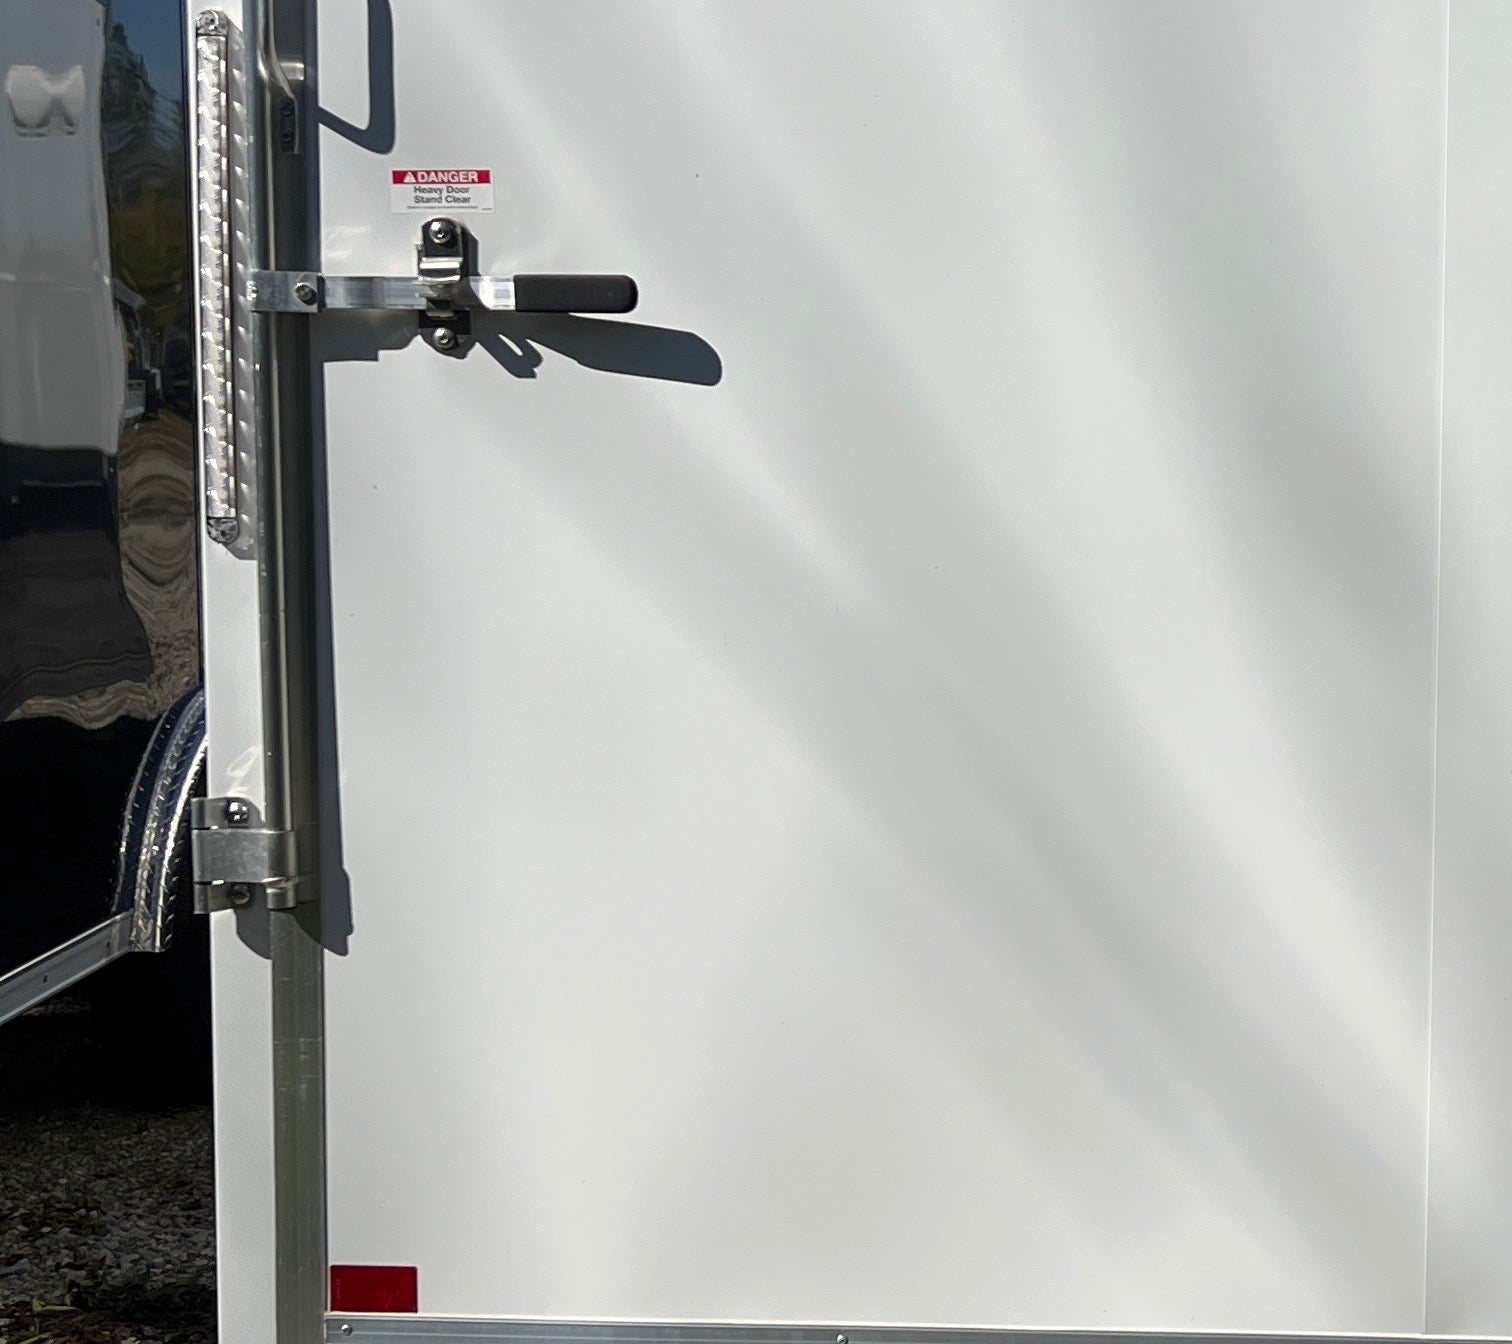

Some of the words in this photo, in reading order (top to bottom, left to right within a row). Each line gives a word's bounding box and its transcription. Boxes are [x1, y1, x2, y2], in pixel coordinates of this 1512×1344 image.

[416, 171, 479, 183] DANGER
[413, 186, 443, 195] Heavy
[446, 186, 470, 194] Door
[414, 195, 443, 203] Stand
[445, 195, 471, 203] Clear
